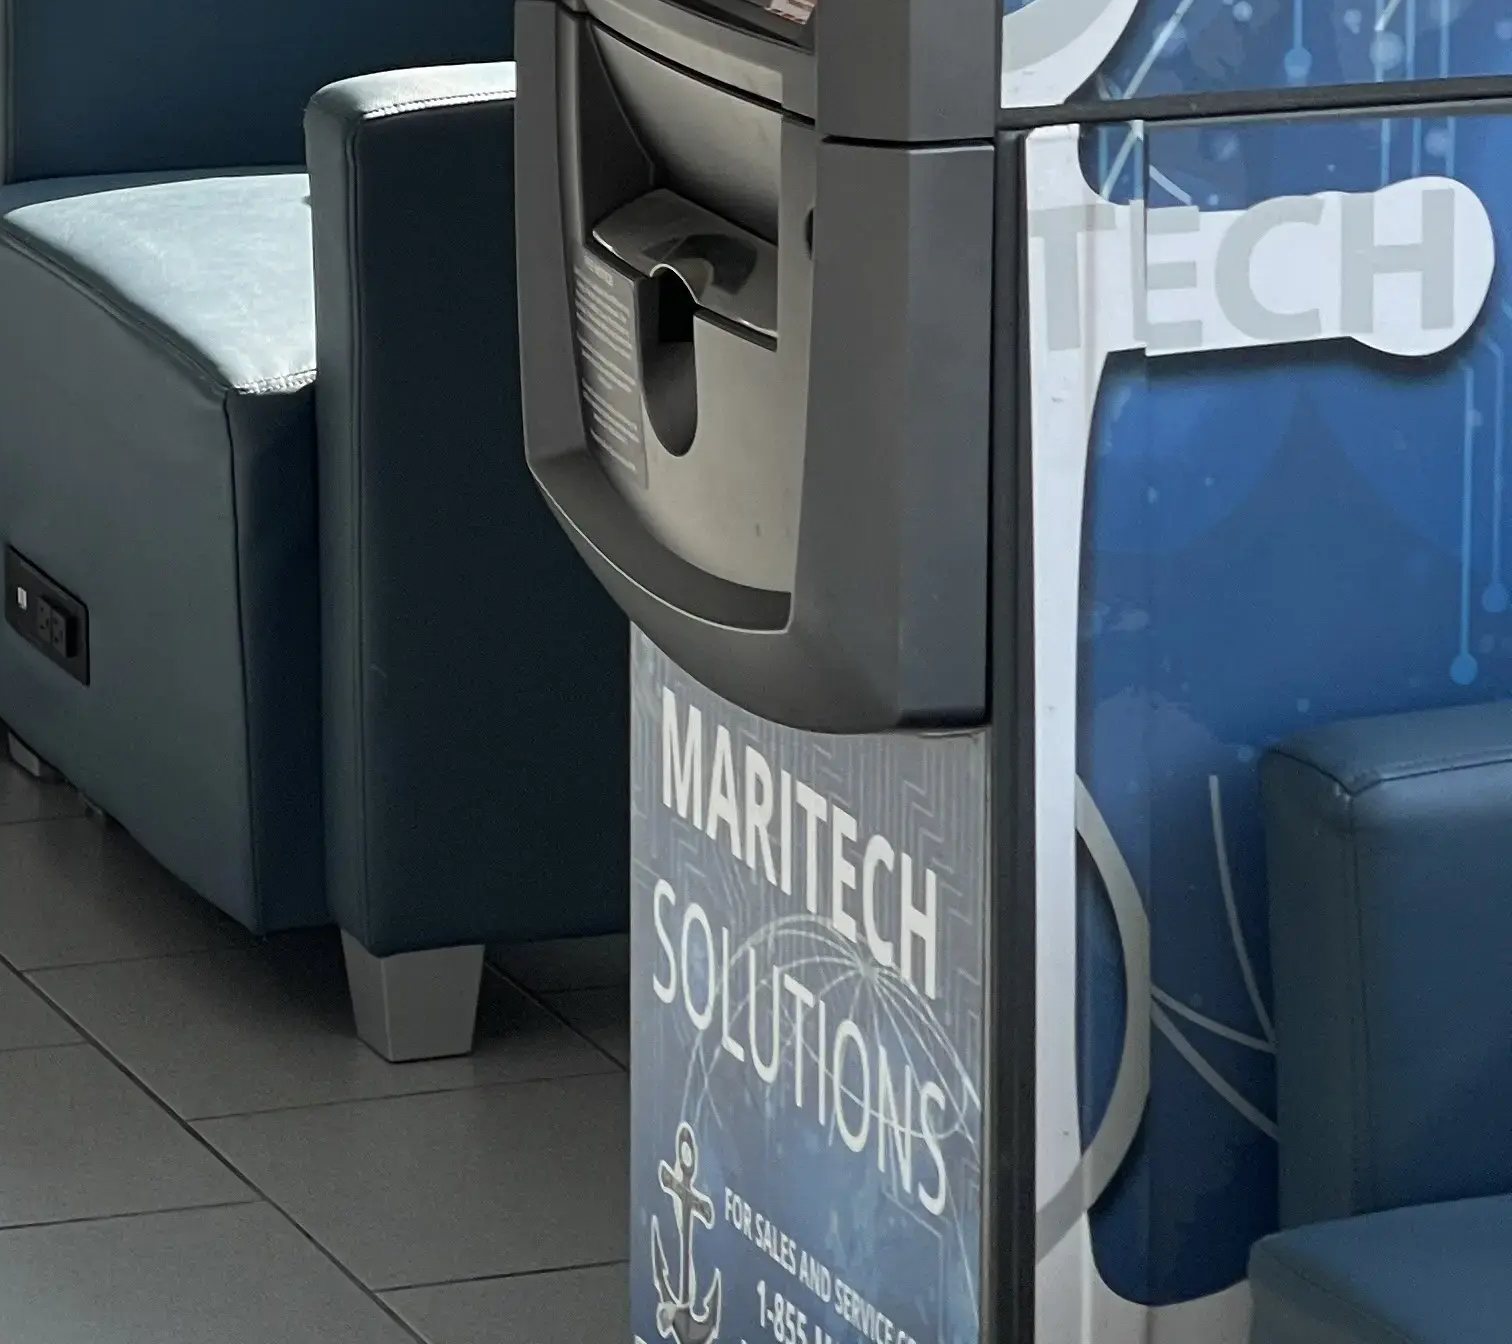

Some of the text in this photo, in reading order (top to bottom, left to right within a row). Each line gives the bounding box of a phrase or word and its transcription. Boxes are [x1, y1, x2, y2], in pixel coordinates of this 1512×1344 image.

[1029, 188, 1456, 352] TECH
[660, 686, 937, 1000] MARITECH
[653, 878, 947, 1216] SOLUTIONS
[724, 1186, 894, 1344] FOR SALES AND SERVICE
